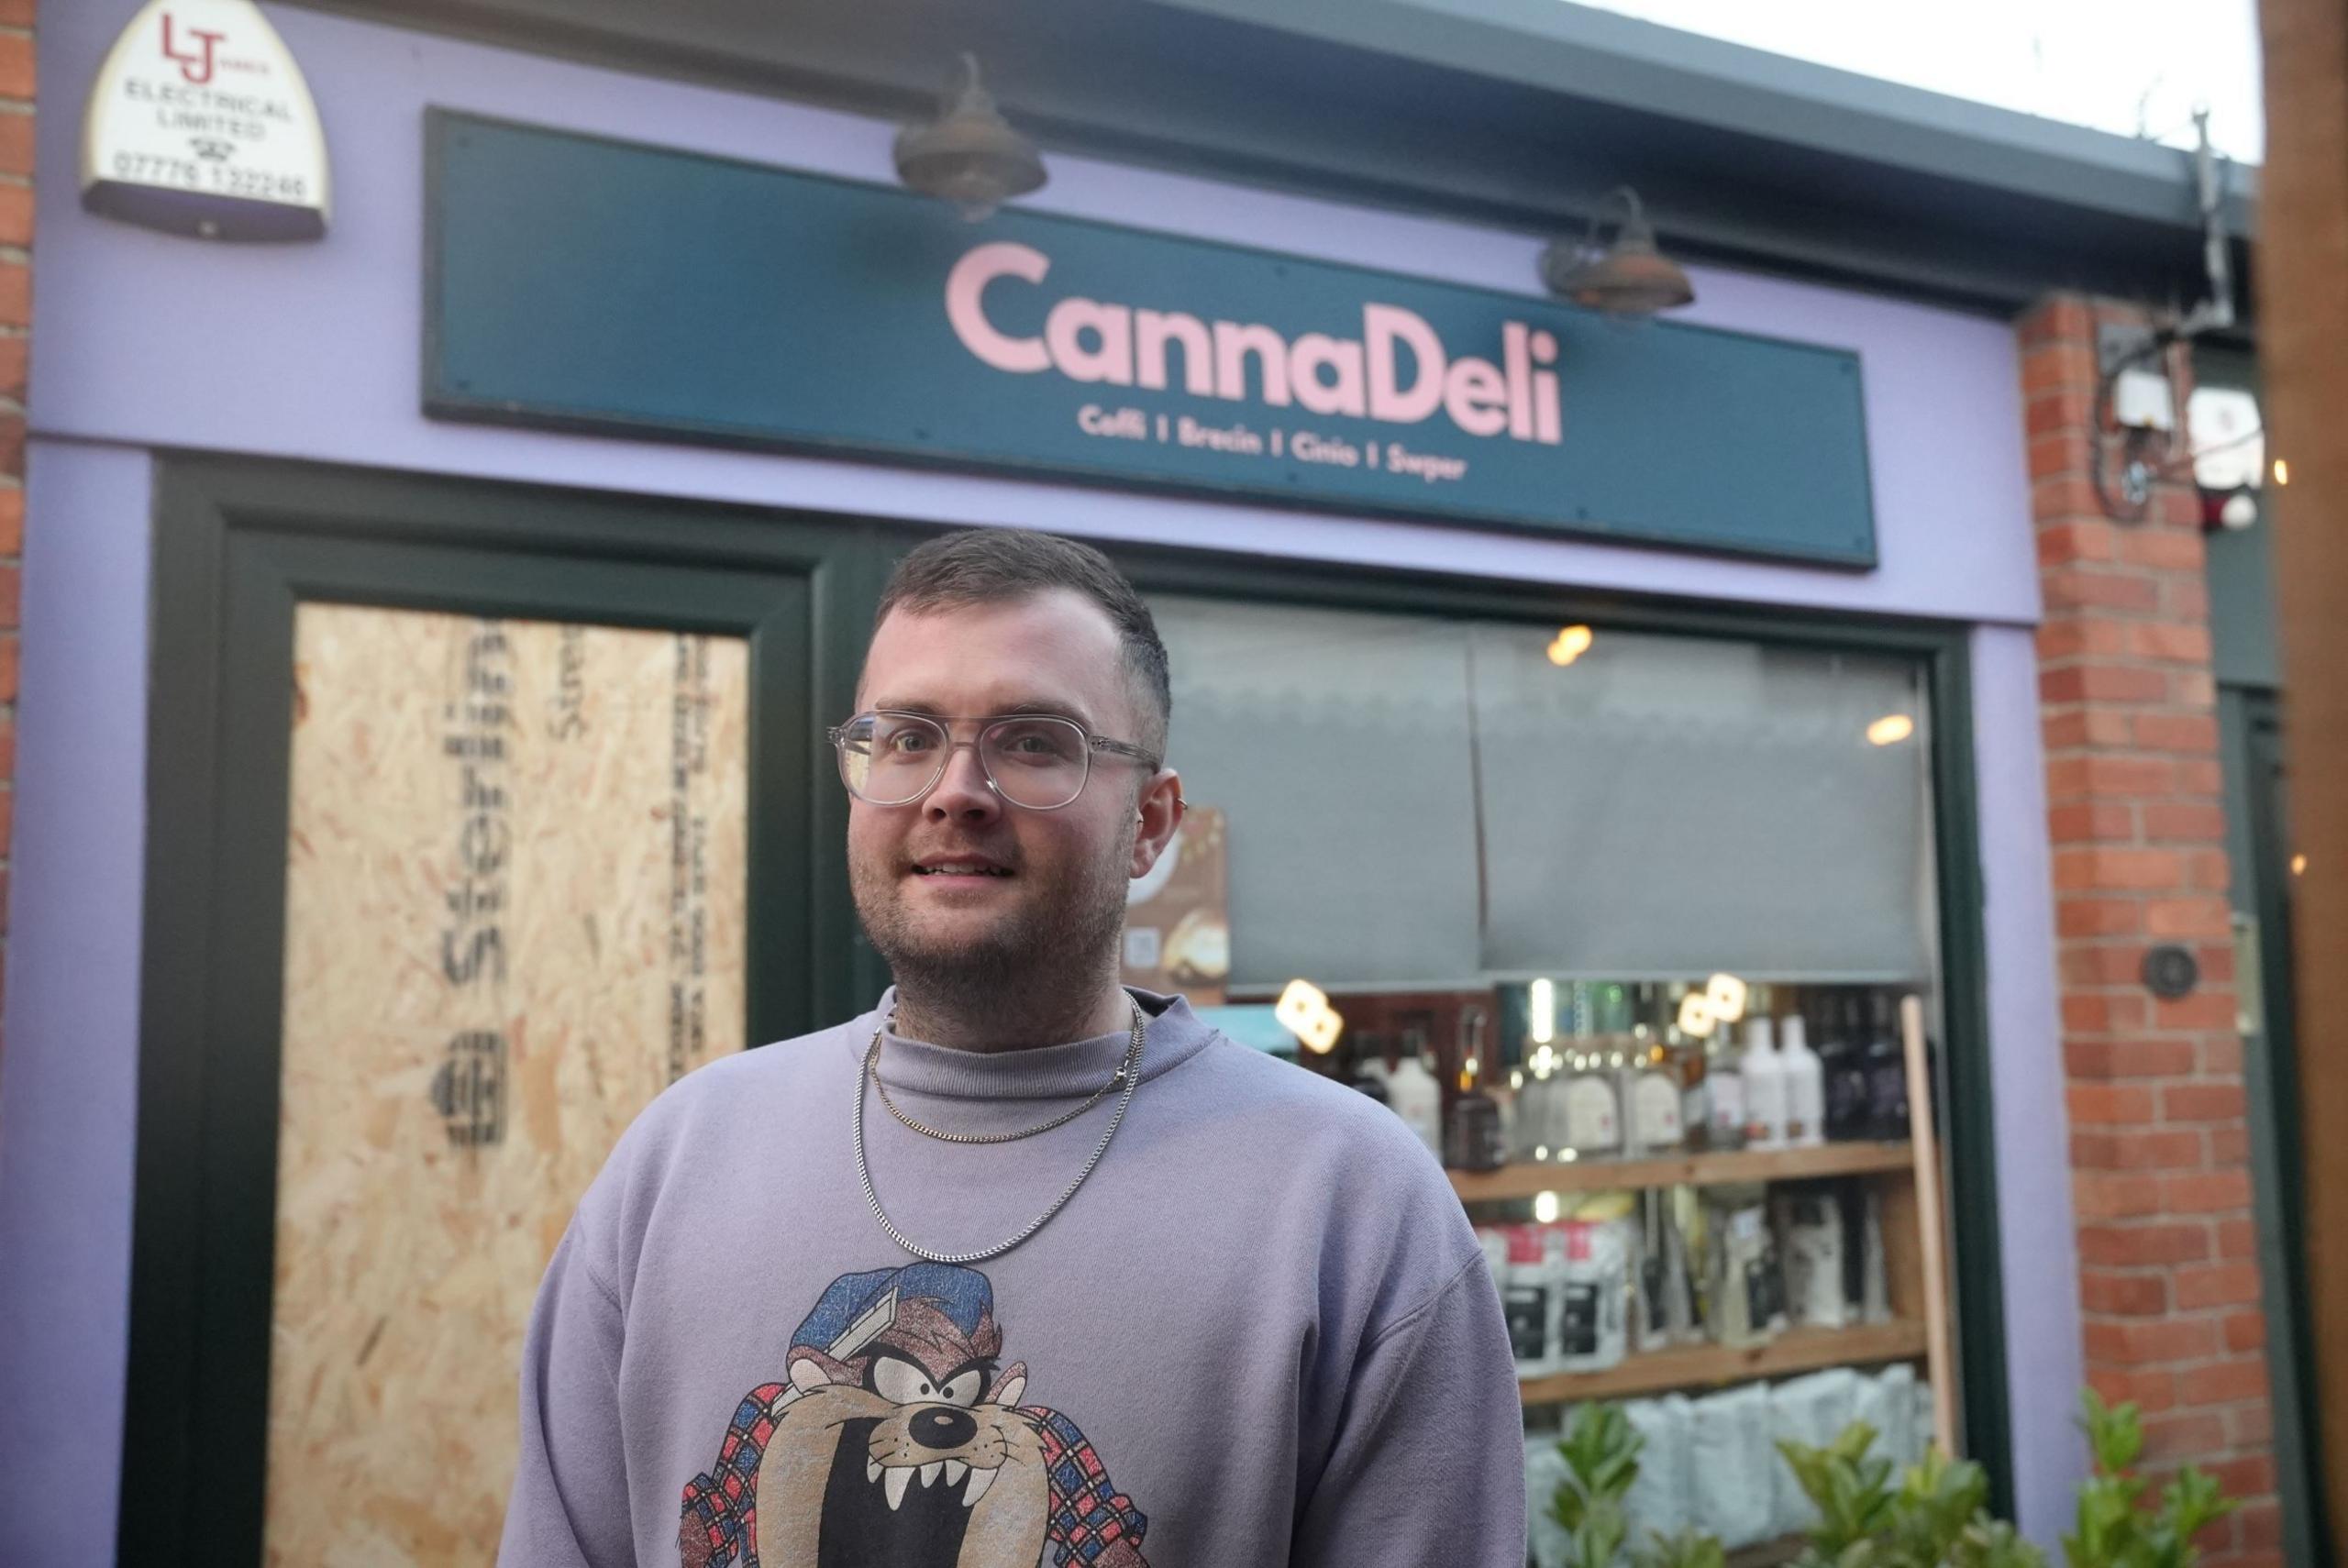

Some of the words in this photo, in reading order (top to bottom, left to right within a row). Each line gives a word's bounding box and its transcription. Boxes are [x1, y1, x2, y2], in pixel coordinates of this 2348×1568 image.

[161, 13, 226, 84] LJ
[124, 78, 292, 121] ELECTRICAL
[157, 109, 266, 139] LIMITED
[945, 241, 1562, 446] CannaDeli
[1078, 403, 1146, 440] Coffi
[1291, 432, 1359, 468] Cinio
[1387, 443, 1468, 483] Swper
[441, 620, 508, 987] Sterlin
